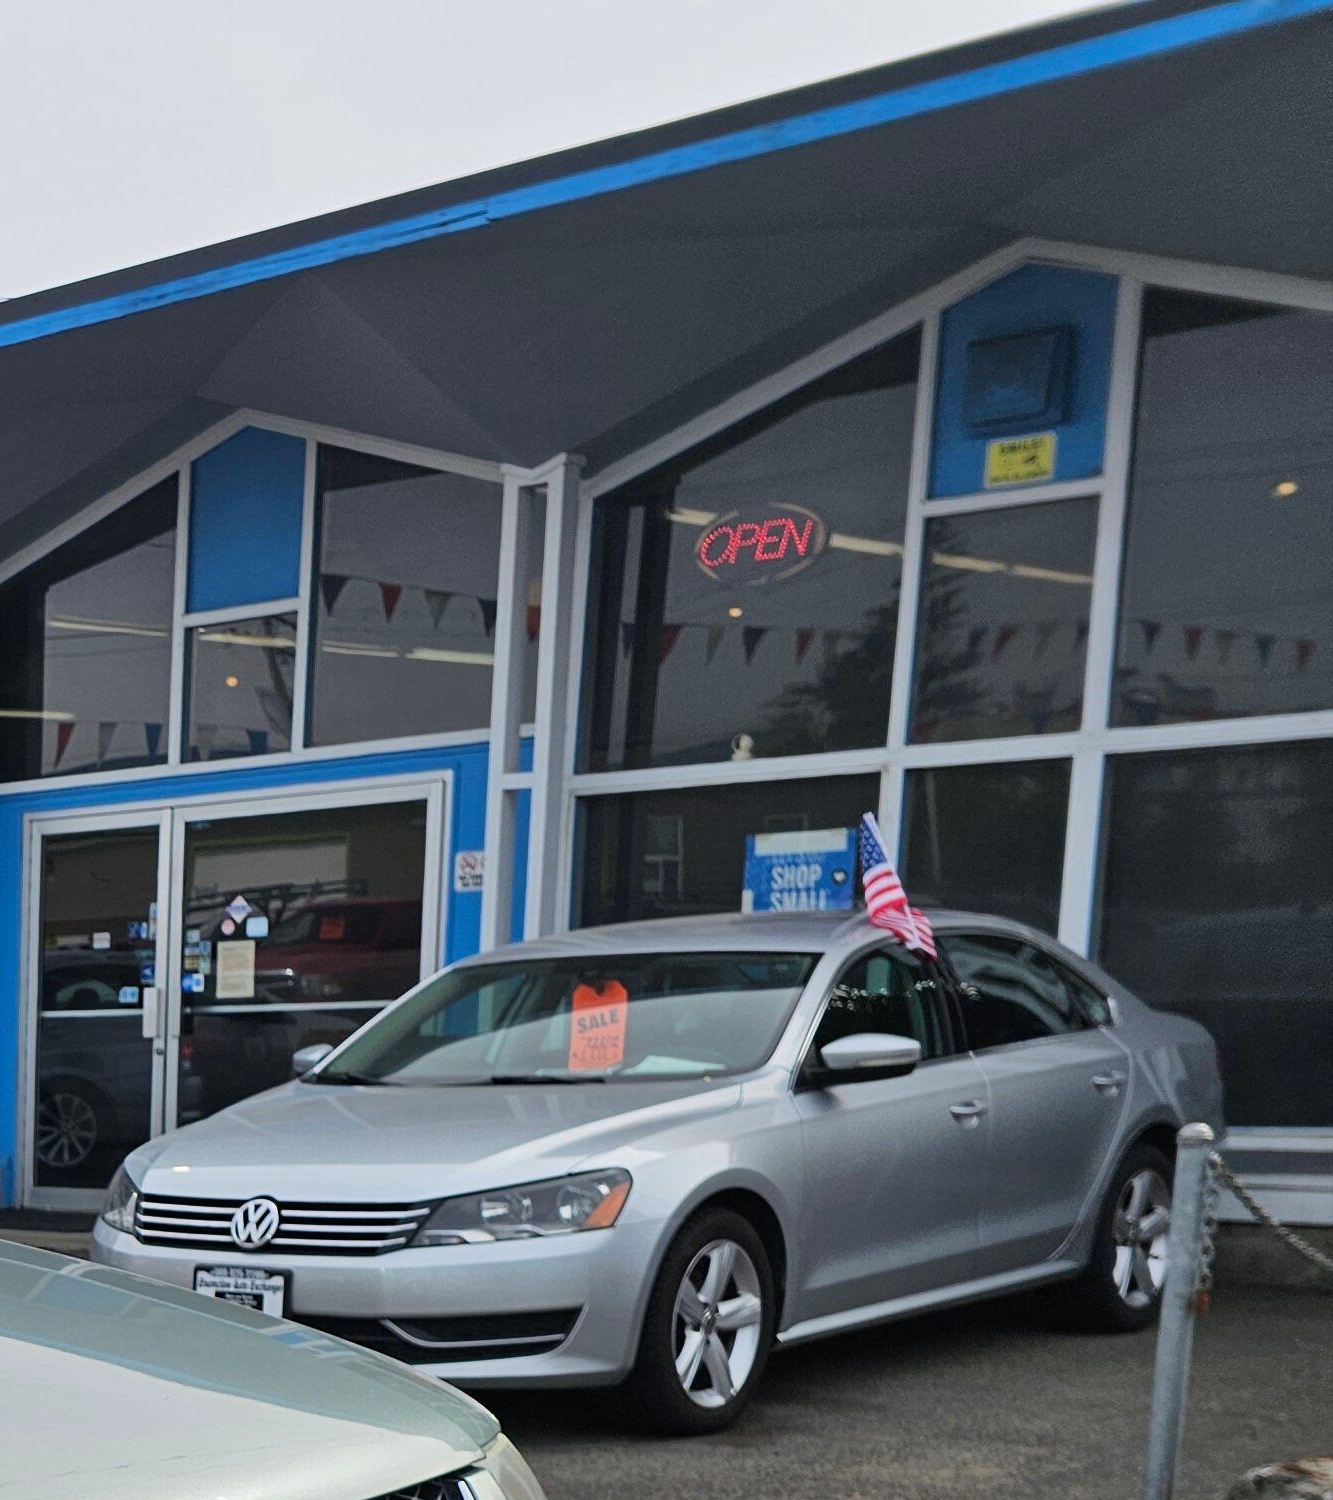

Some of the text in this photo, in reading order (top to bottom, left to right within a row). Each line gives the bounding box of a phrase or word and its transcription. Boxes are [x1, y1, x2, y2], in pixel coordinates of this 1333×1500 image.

[699, 517, 813, 567] OPEN
[770, 864, 823, 889] SHOP
[577, 1007, 620, 1034] SALE
